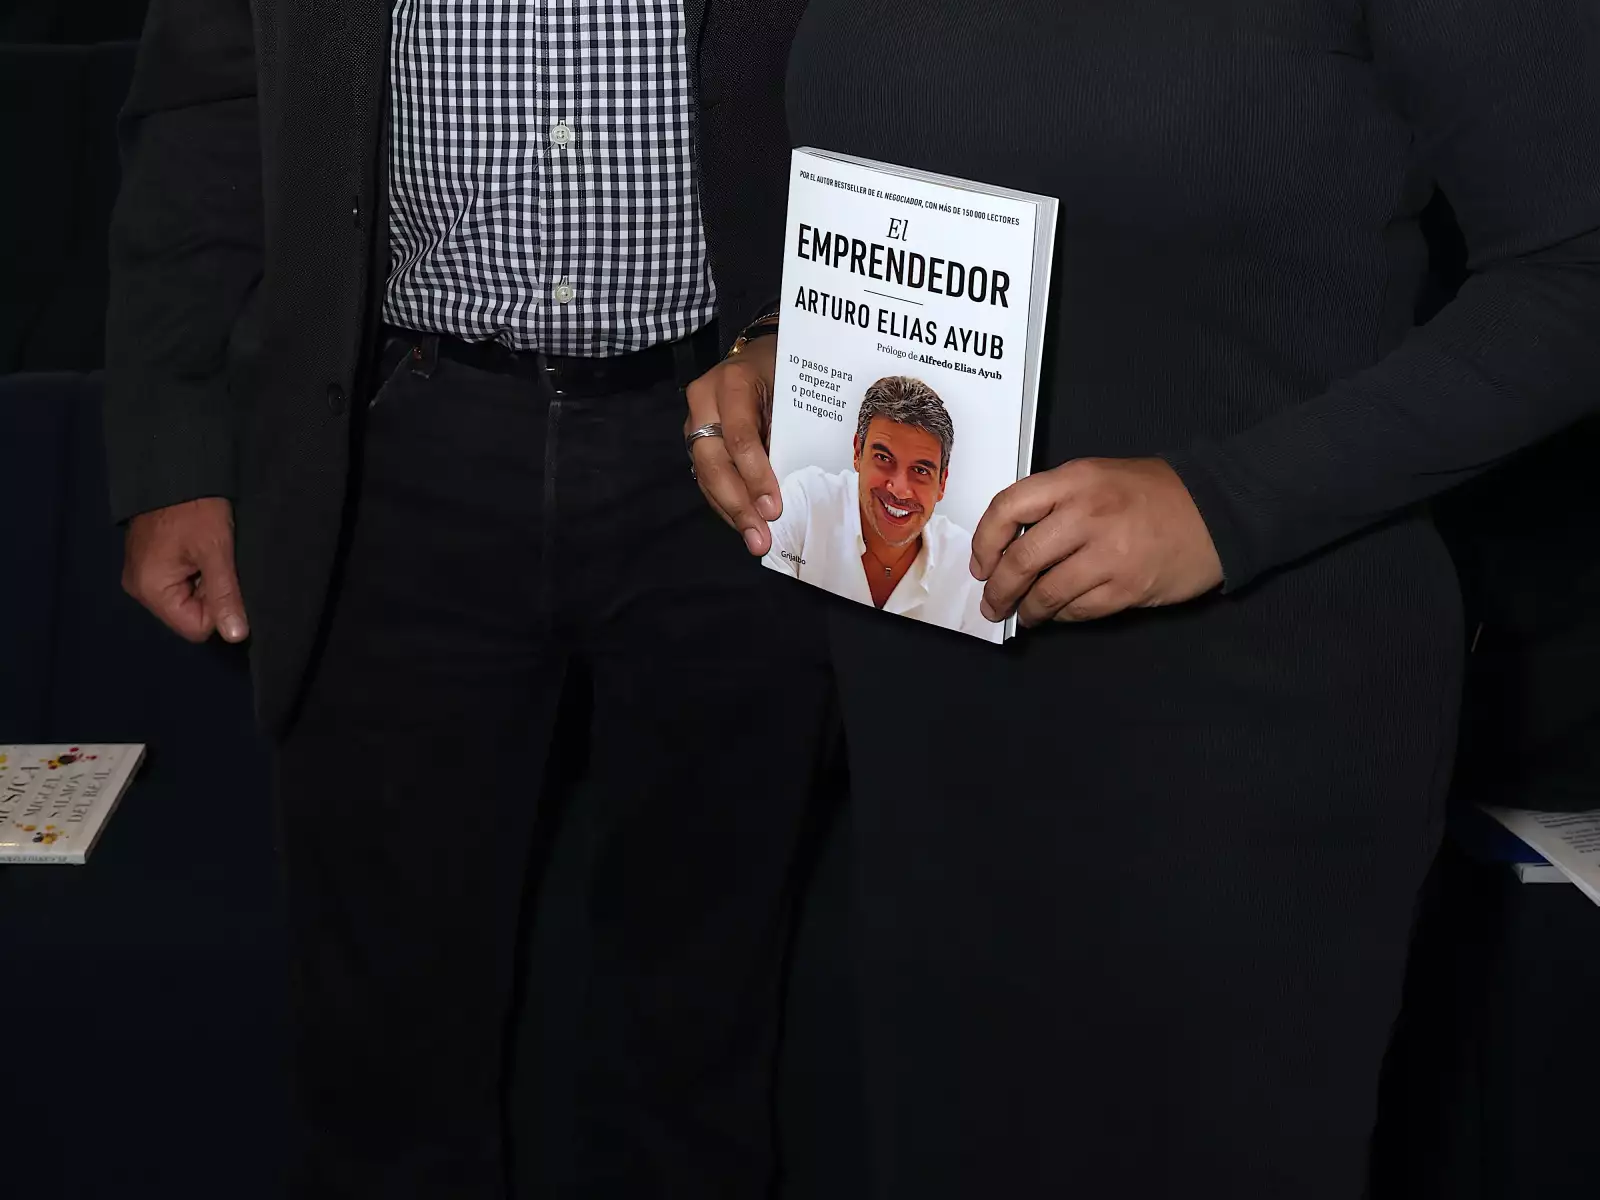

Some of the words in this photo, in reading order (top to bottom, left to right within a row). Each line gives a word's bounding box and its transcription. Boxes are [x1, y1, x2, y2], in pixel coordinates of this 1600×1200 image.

[800, 170, 810, 180] POR
[810, 173, 816, 182] EL
[817, 175, 834, 187] AUTOR
[834, 179, 867, 195] BESTSELLER
[867, 188, 876, 197] DE
[876, 190, 884, 199] EL
[884, 192, 924, 209] NEGOCIADOR,
[924, 200, 938, 210] CON
[938, 202, 952, 213] MÁS
[952, 206, 961, 215] DE
[987, 213, 1020, 226] LECTORES
[886, 216, 909, 242] El
[797, 222, 1010, 309] EMPRENDEDOR
[794, 285, 870, 329] ARTURO
[877, 308, 938, 346] ELIAS
[943, 325, 1004, 361] AYUB
[789, 354, 800, 365] 10
[801, 358, 829, 374] pasos
[830, 368, 853, 382] para
[876, 342, 907, 360] Prólogo
[910, 350, 919, 361] de
[919, 354, 953, 371] Alfredo
[954, 362, 978, 375] Elias
[978, 367, 1003, 381] Ayub
[798, 372, 841, 392] empezar
[791, 384, 797, 393] o
[799, 386, 847, 409] potenciar
[793, 397, 803, 409] tu
[806, 403, 844, 423] negocio
[780, 550, 806, 565] Grijalbo
